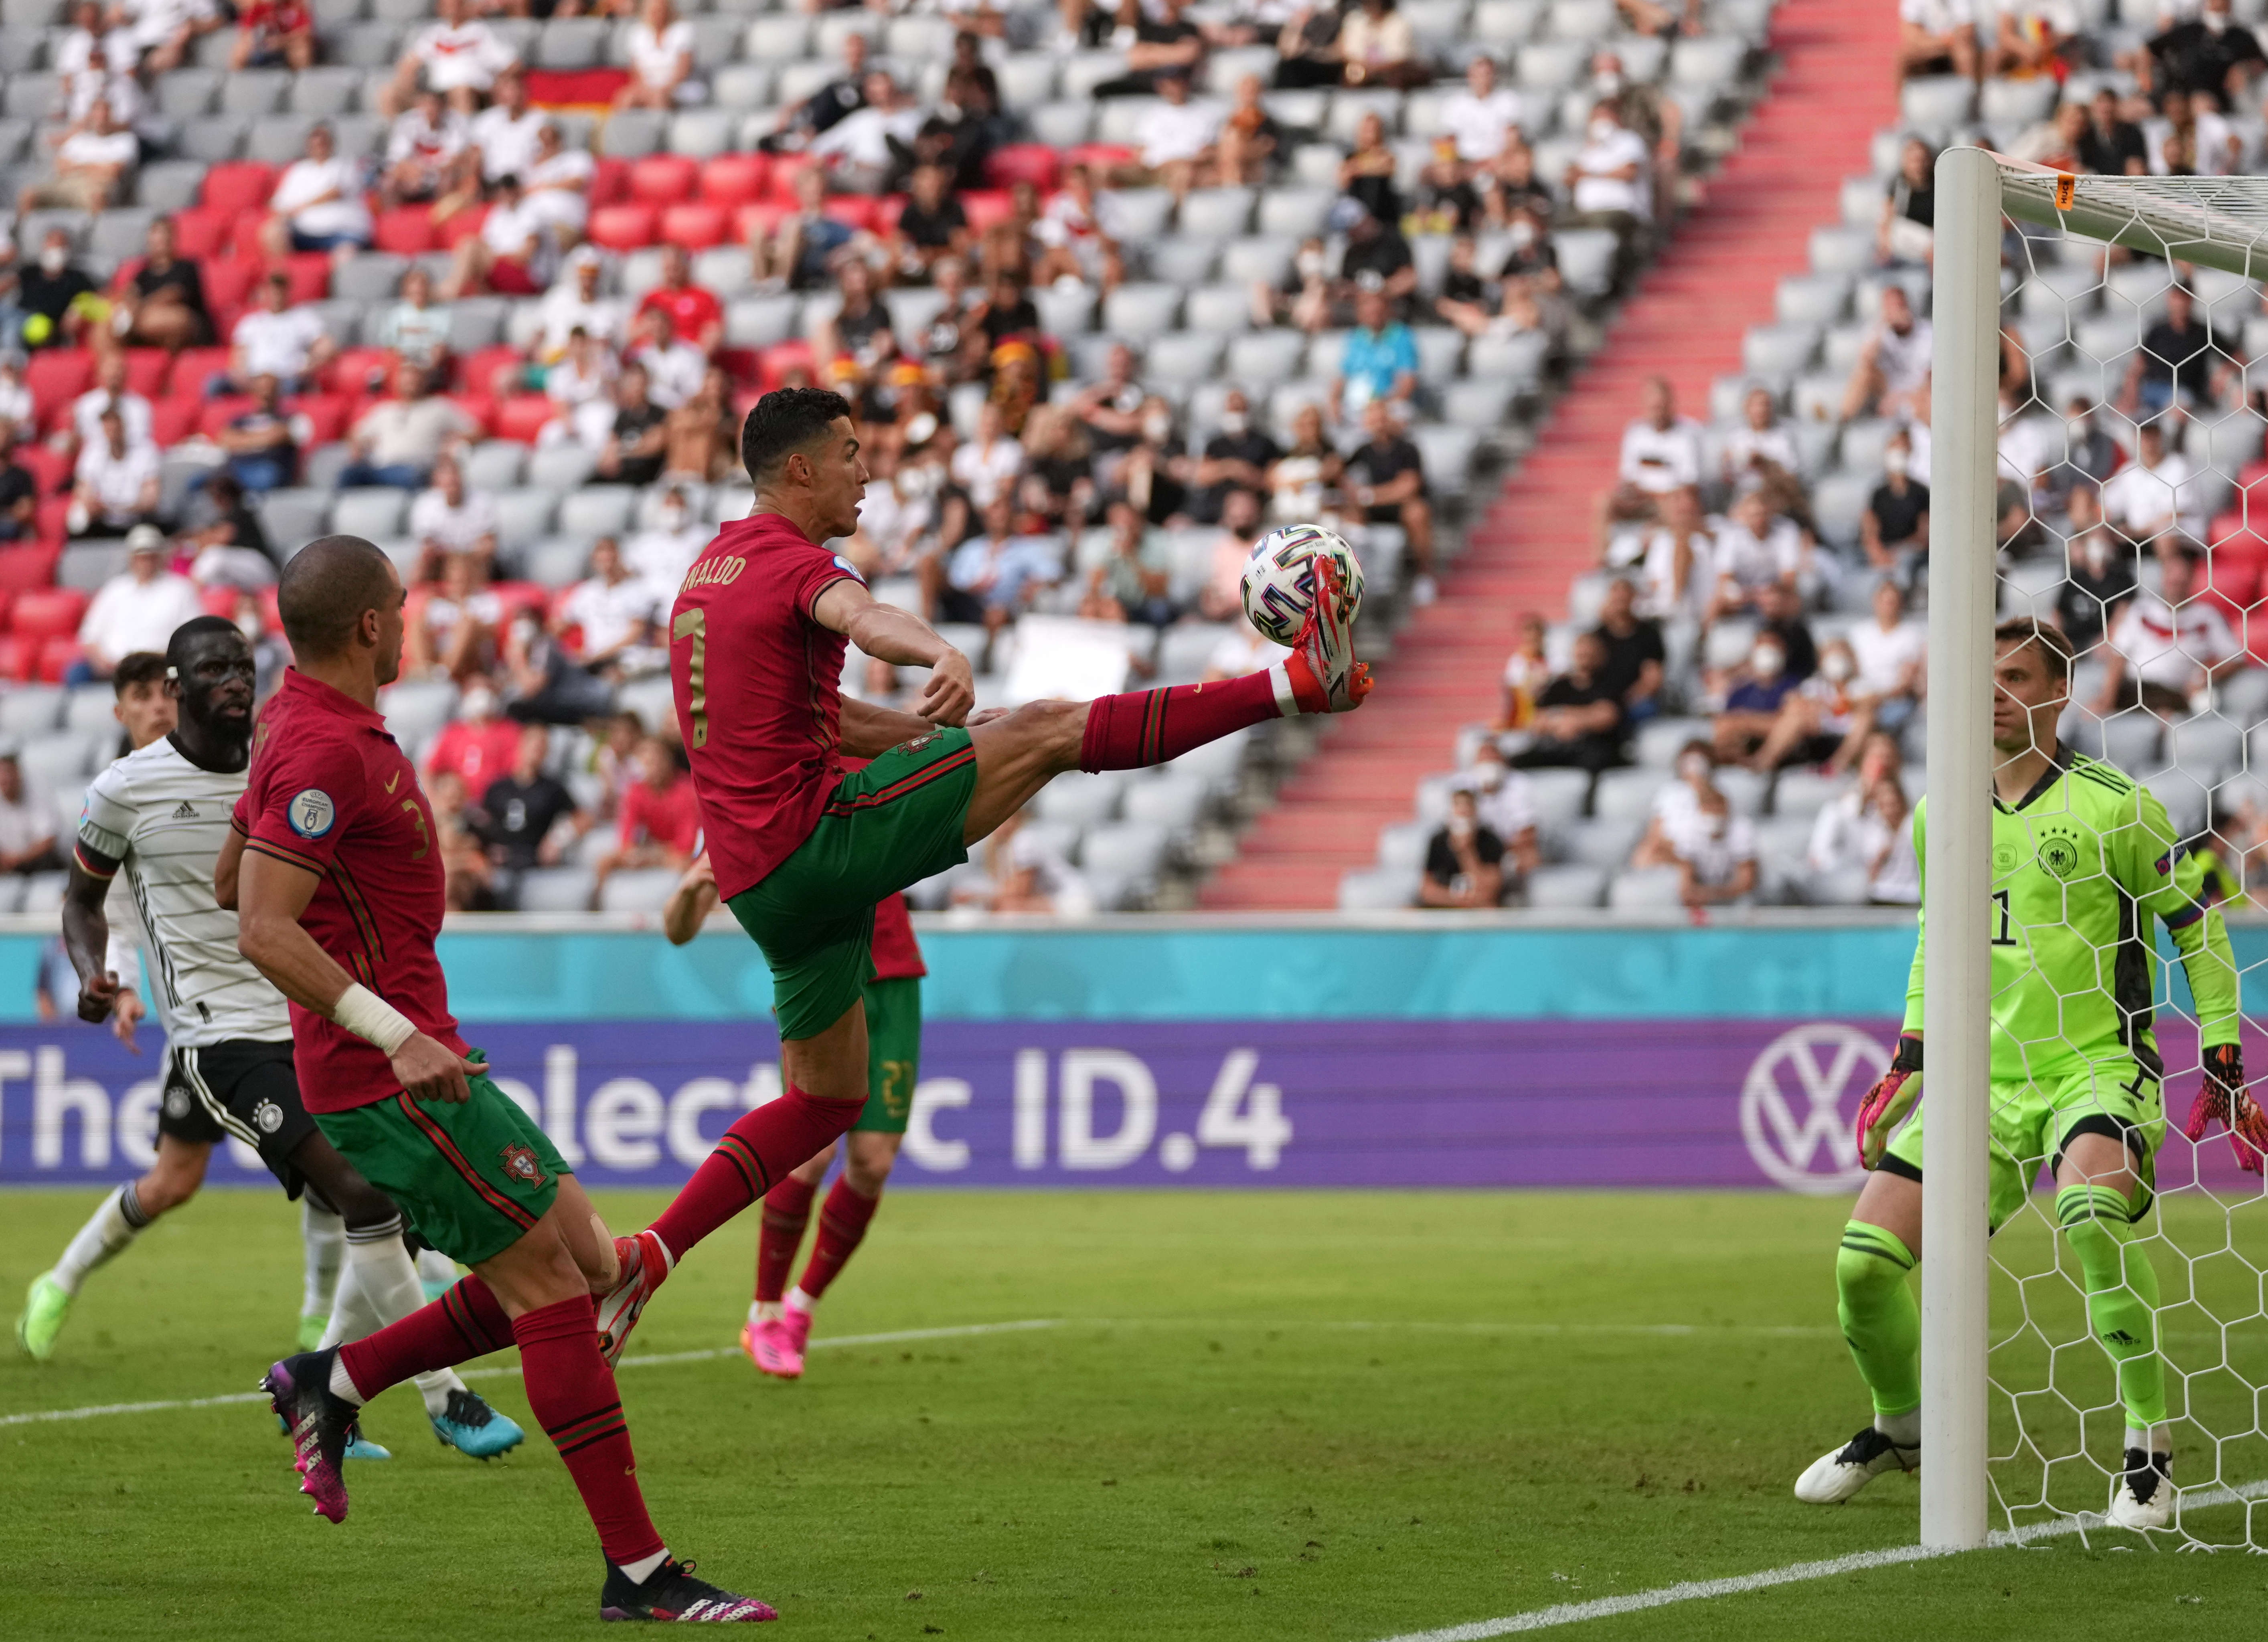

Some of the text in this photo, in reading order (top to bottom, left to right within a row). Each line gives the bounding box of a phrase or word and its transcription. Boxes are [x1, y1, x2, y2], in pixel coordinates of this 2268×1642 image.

[677, 556, 747, 599] NALDO
[673, 608, 708, 749] 7
[302, 797, 328, 807] EUROPEAN
[302, 802, 327, 811] CHAMPIONS
[401, 799, 429, 859] 3
[1012, 1046, 1294, 1174] ID.4
